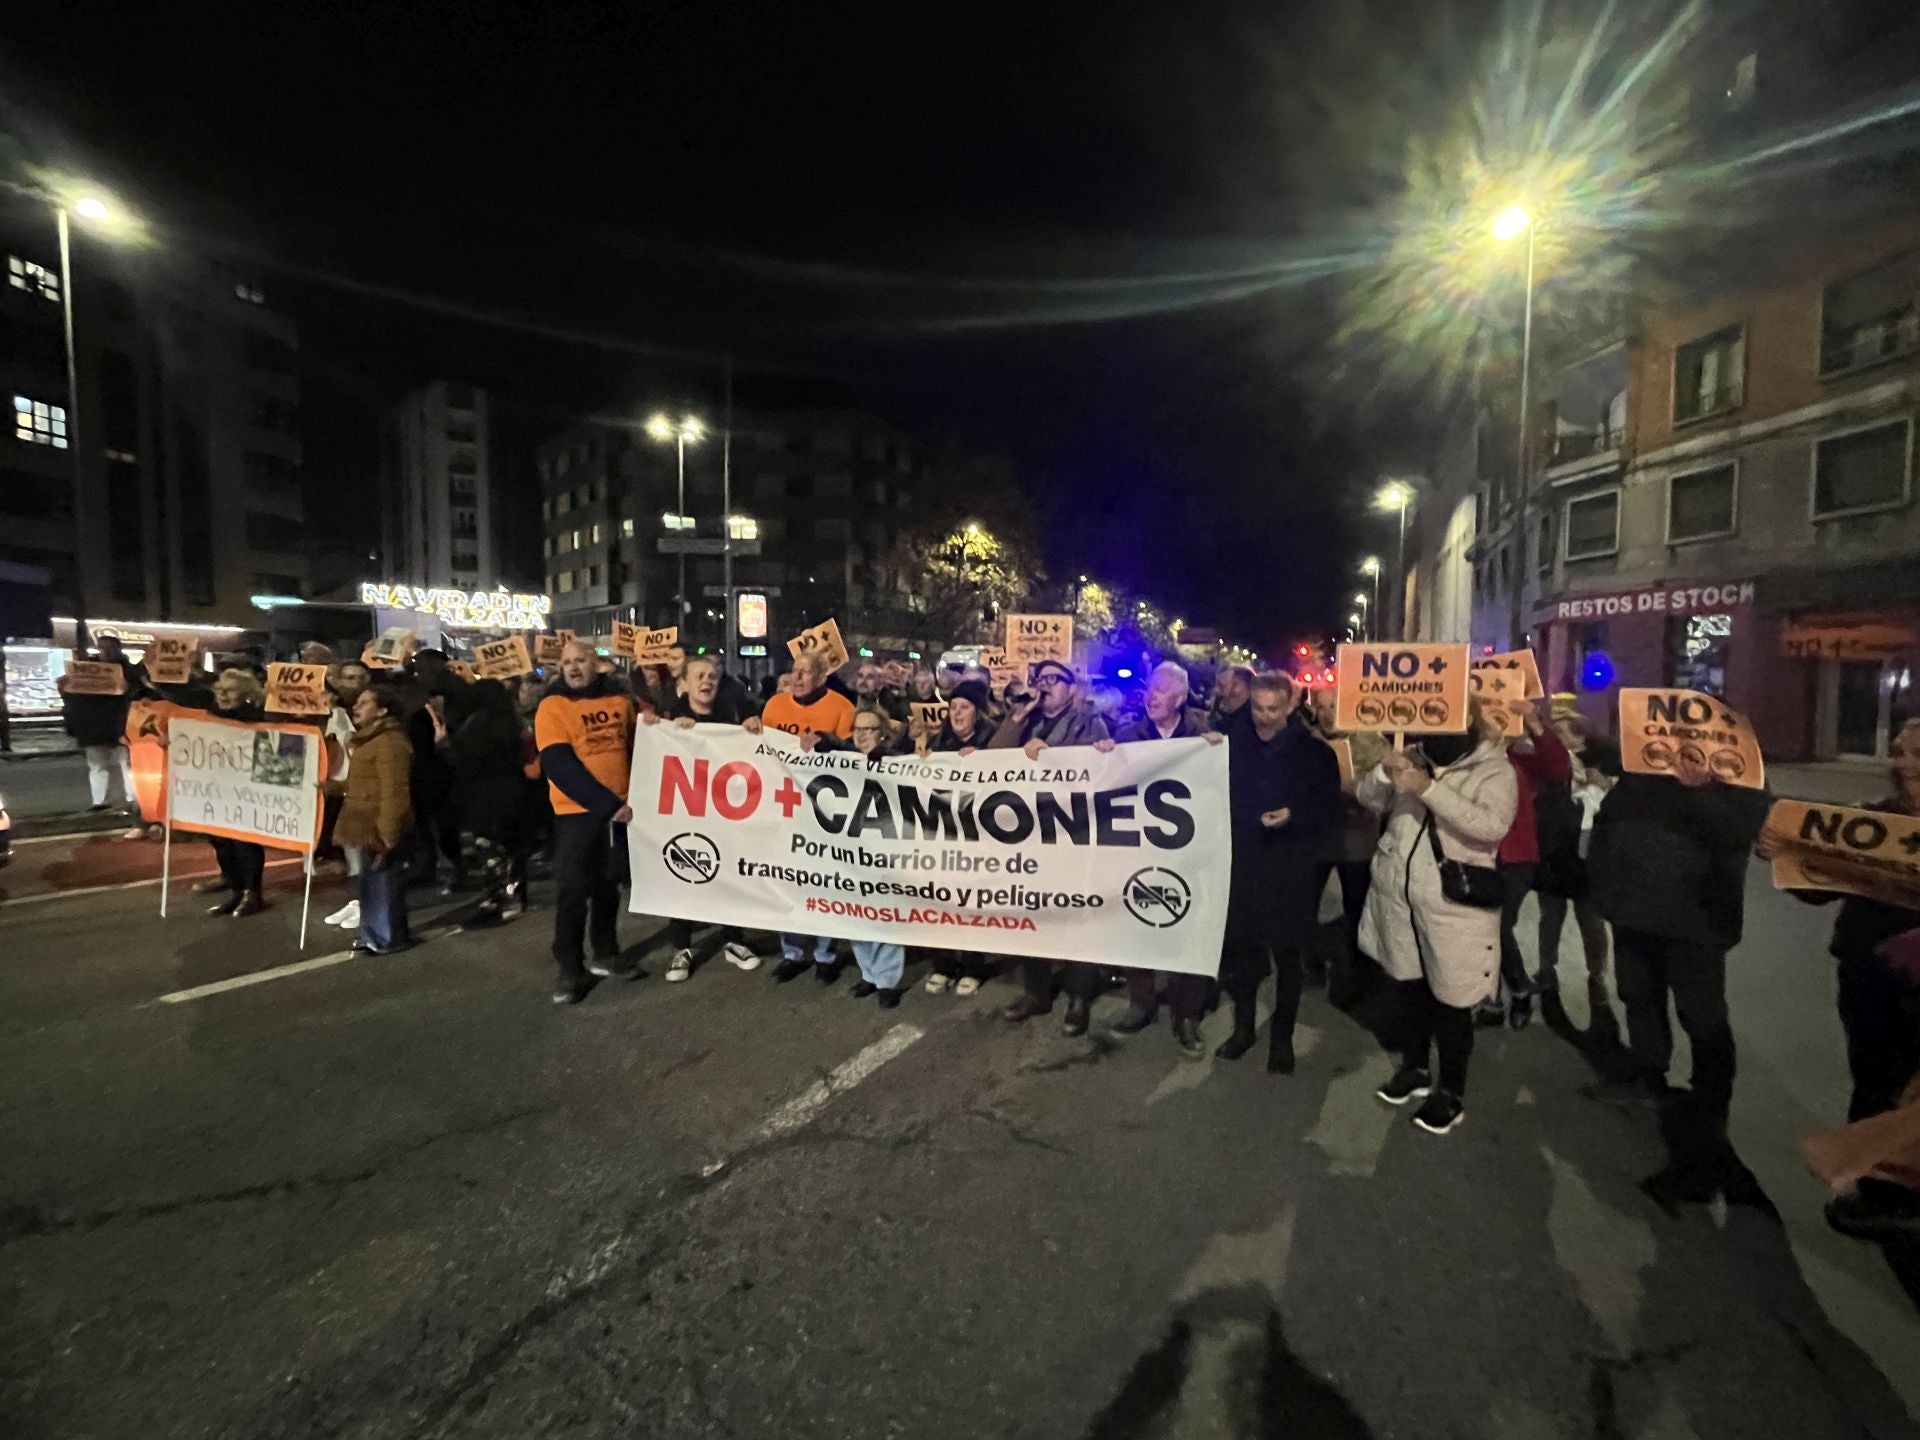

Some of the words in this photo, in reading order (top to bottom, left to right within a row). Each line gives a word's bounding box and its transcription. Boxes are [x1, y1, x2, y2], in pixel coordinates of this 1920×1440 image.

[362, 582, 511, 614] NAVIDAD
[1558, 595, 1633, 619] RESTOS
[1638, 591, 1666, 611] DE
[418, 607, 548, 631] ALZADA
[618, 625, 634, 638] NO
[1019, 620, 1047, 634] NO
[482, 644, 507, 660] NO
[645, 632, 664, 645] NO
[277, 667, 304, 684] NO
[1362, 651, 1420, 679] NO
[1428, 656, 1448, 675] +
[1359, 681, 1444, 694] CAMIONES
[581, 710, 609, 727] NO
[1647, 695, 1712, 725] NO
[840, 758, 860, 770] DE
[867, 760, 945, 780] VECINOS
[949, 769, 972, 783] DE
[978, 770, 998, 783] LA
[1004, 769, 1091, 783] CALZADA
[658, 755, 762, 820] NO
[806, 774, 1195, 850] CAMIONES
[203, 801, 215, 821] A
[225, 803, 243, 824] LA
[254, 807, 299, 837] LUCHA
[1800, 809, 1888, 850] NO
[791, 833, 827, 858] Por
[831, 847, 855, 865] un
[859, 847, 937, 872] barrio
[941, 850, 1001, 873] libre
[1005, 852, 1039, 874] de
[738, 857, 855, 892] transporte
[859, 880, 952, 901] pesado
[956, 888, 972, 907] y
[976, 884, 1104, 911] peligroso
[805, 897, 1037, 932] #SOMOSLACALZADA
